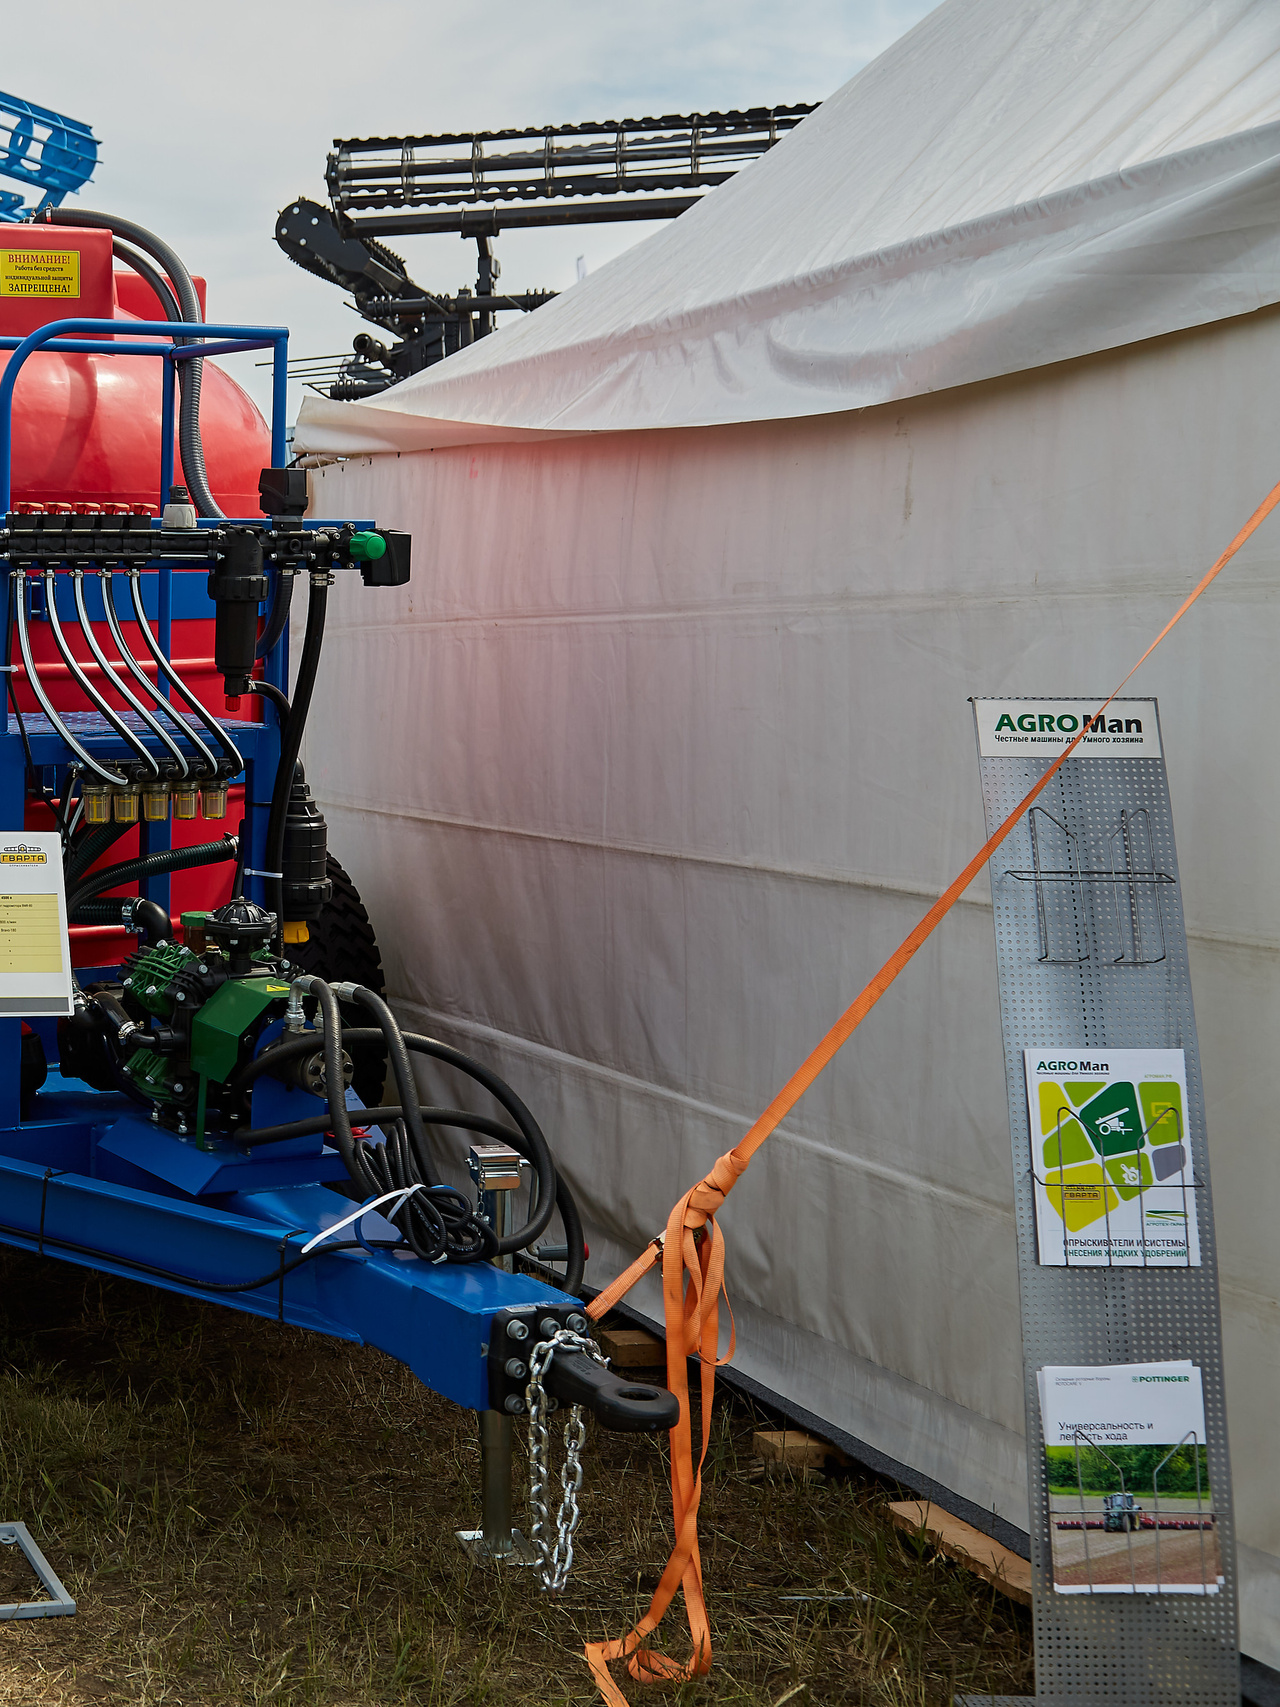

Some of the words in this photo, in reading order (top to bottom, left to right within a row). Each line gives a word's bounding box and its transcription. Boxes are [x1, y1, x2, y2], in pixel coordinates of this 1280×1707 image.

[8, 254, 70, 264] ВНИМАНИЕ!
[8, 283, 70, 293] ЗАПРЕЩЕНА!
[1058, 1422, 1145, 1432] Универсальность
[1105, 1433, 1128, 1441] хода
